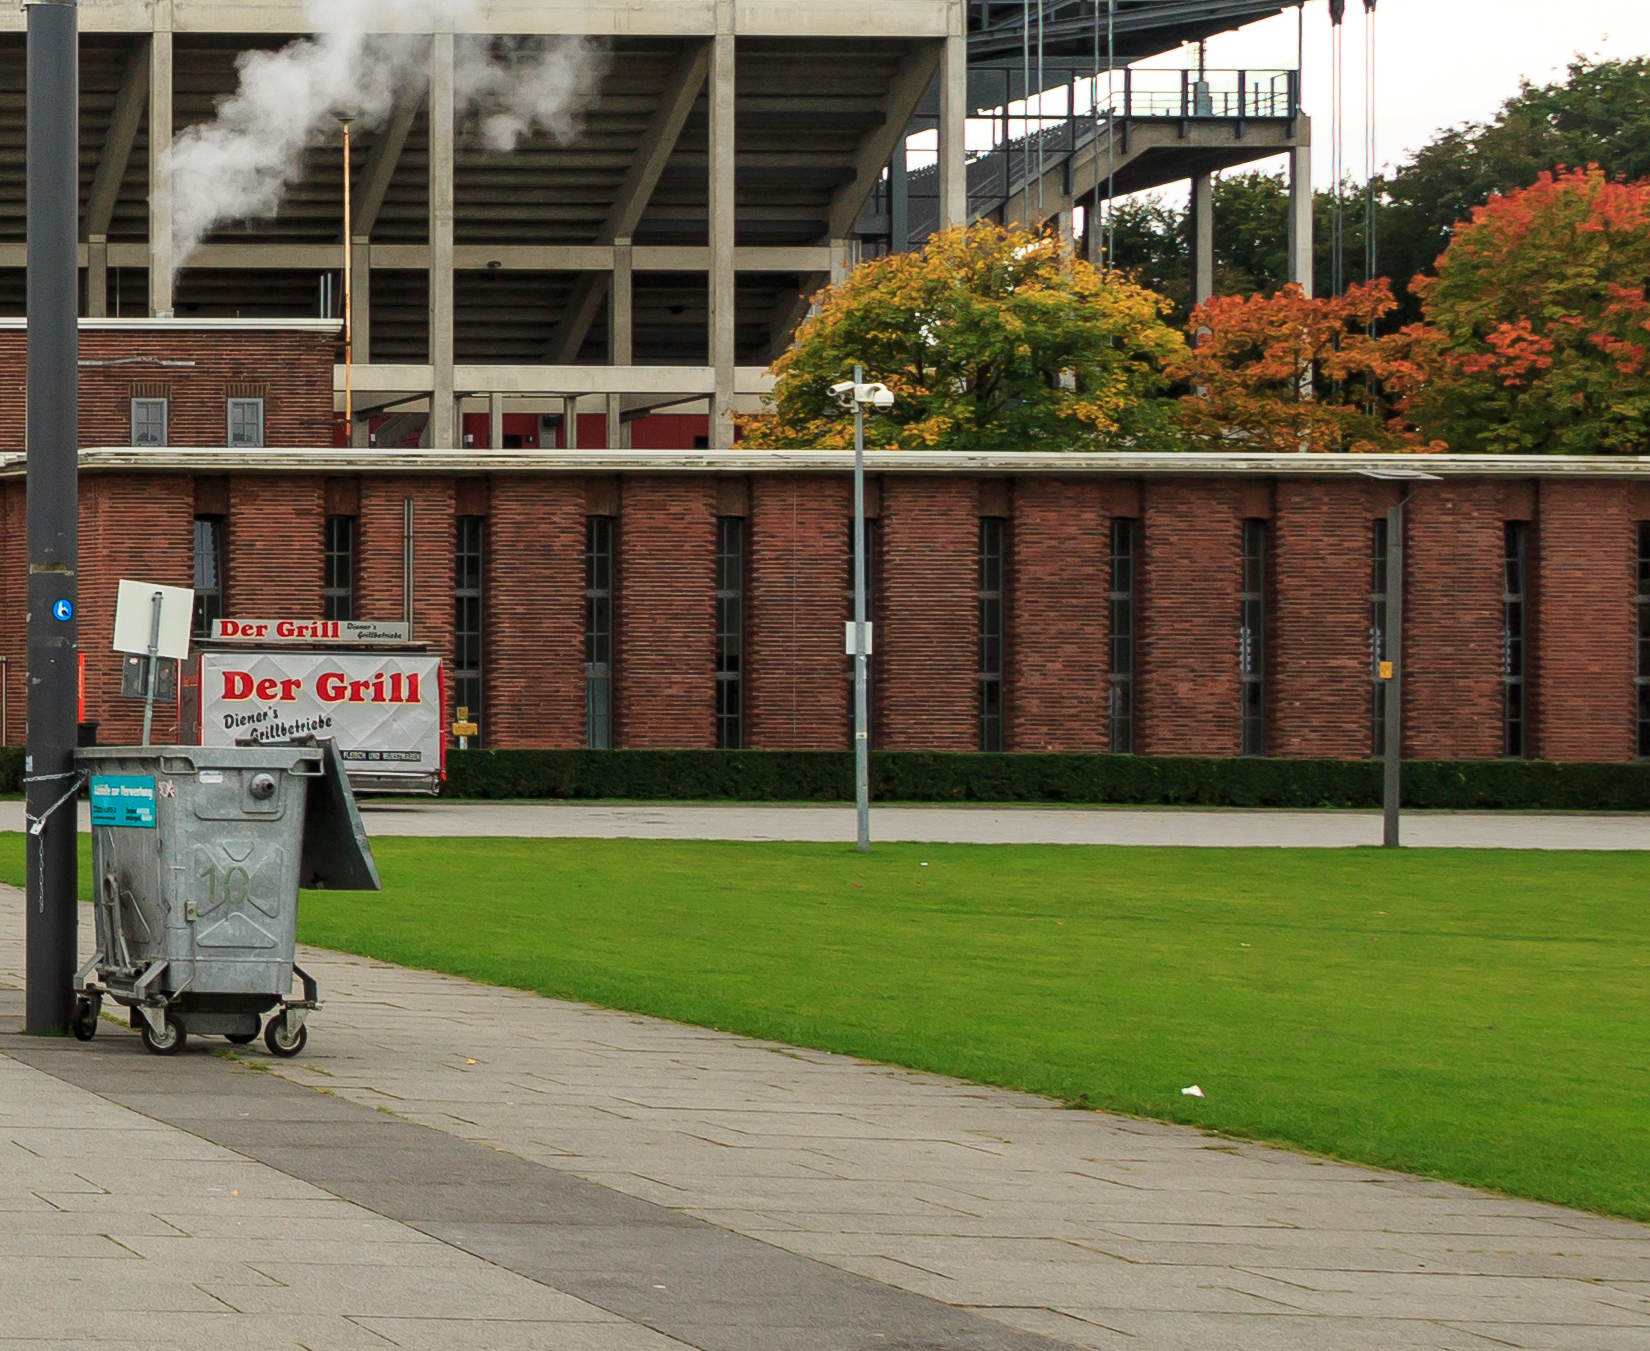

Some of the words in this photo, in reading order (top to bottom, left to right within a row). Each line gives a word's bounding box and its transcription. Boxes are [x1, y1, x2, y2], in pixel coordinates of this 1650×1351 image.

[220, 619, 269, 638] Der
[276, 620, 341, 639] Grill
[222, 671, 302, 702] Der
[316, 672, 422, 704] Grill
[250, 714, 332, 741] Grillbetriebe
[200, 864, 249, 905] 10
